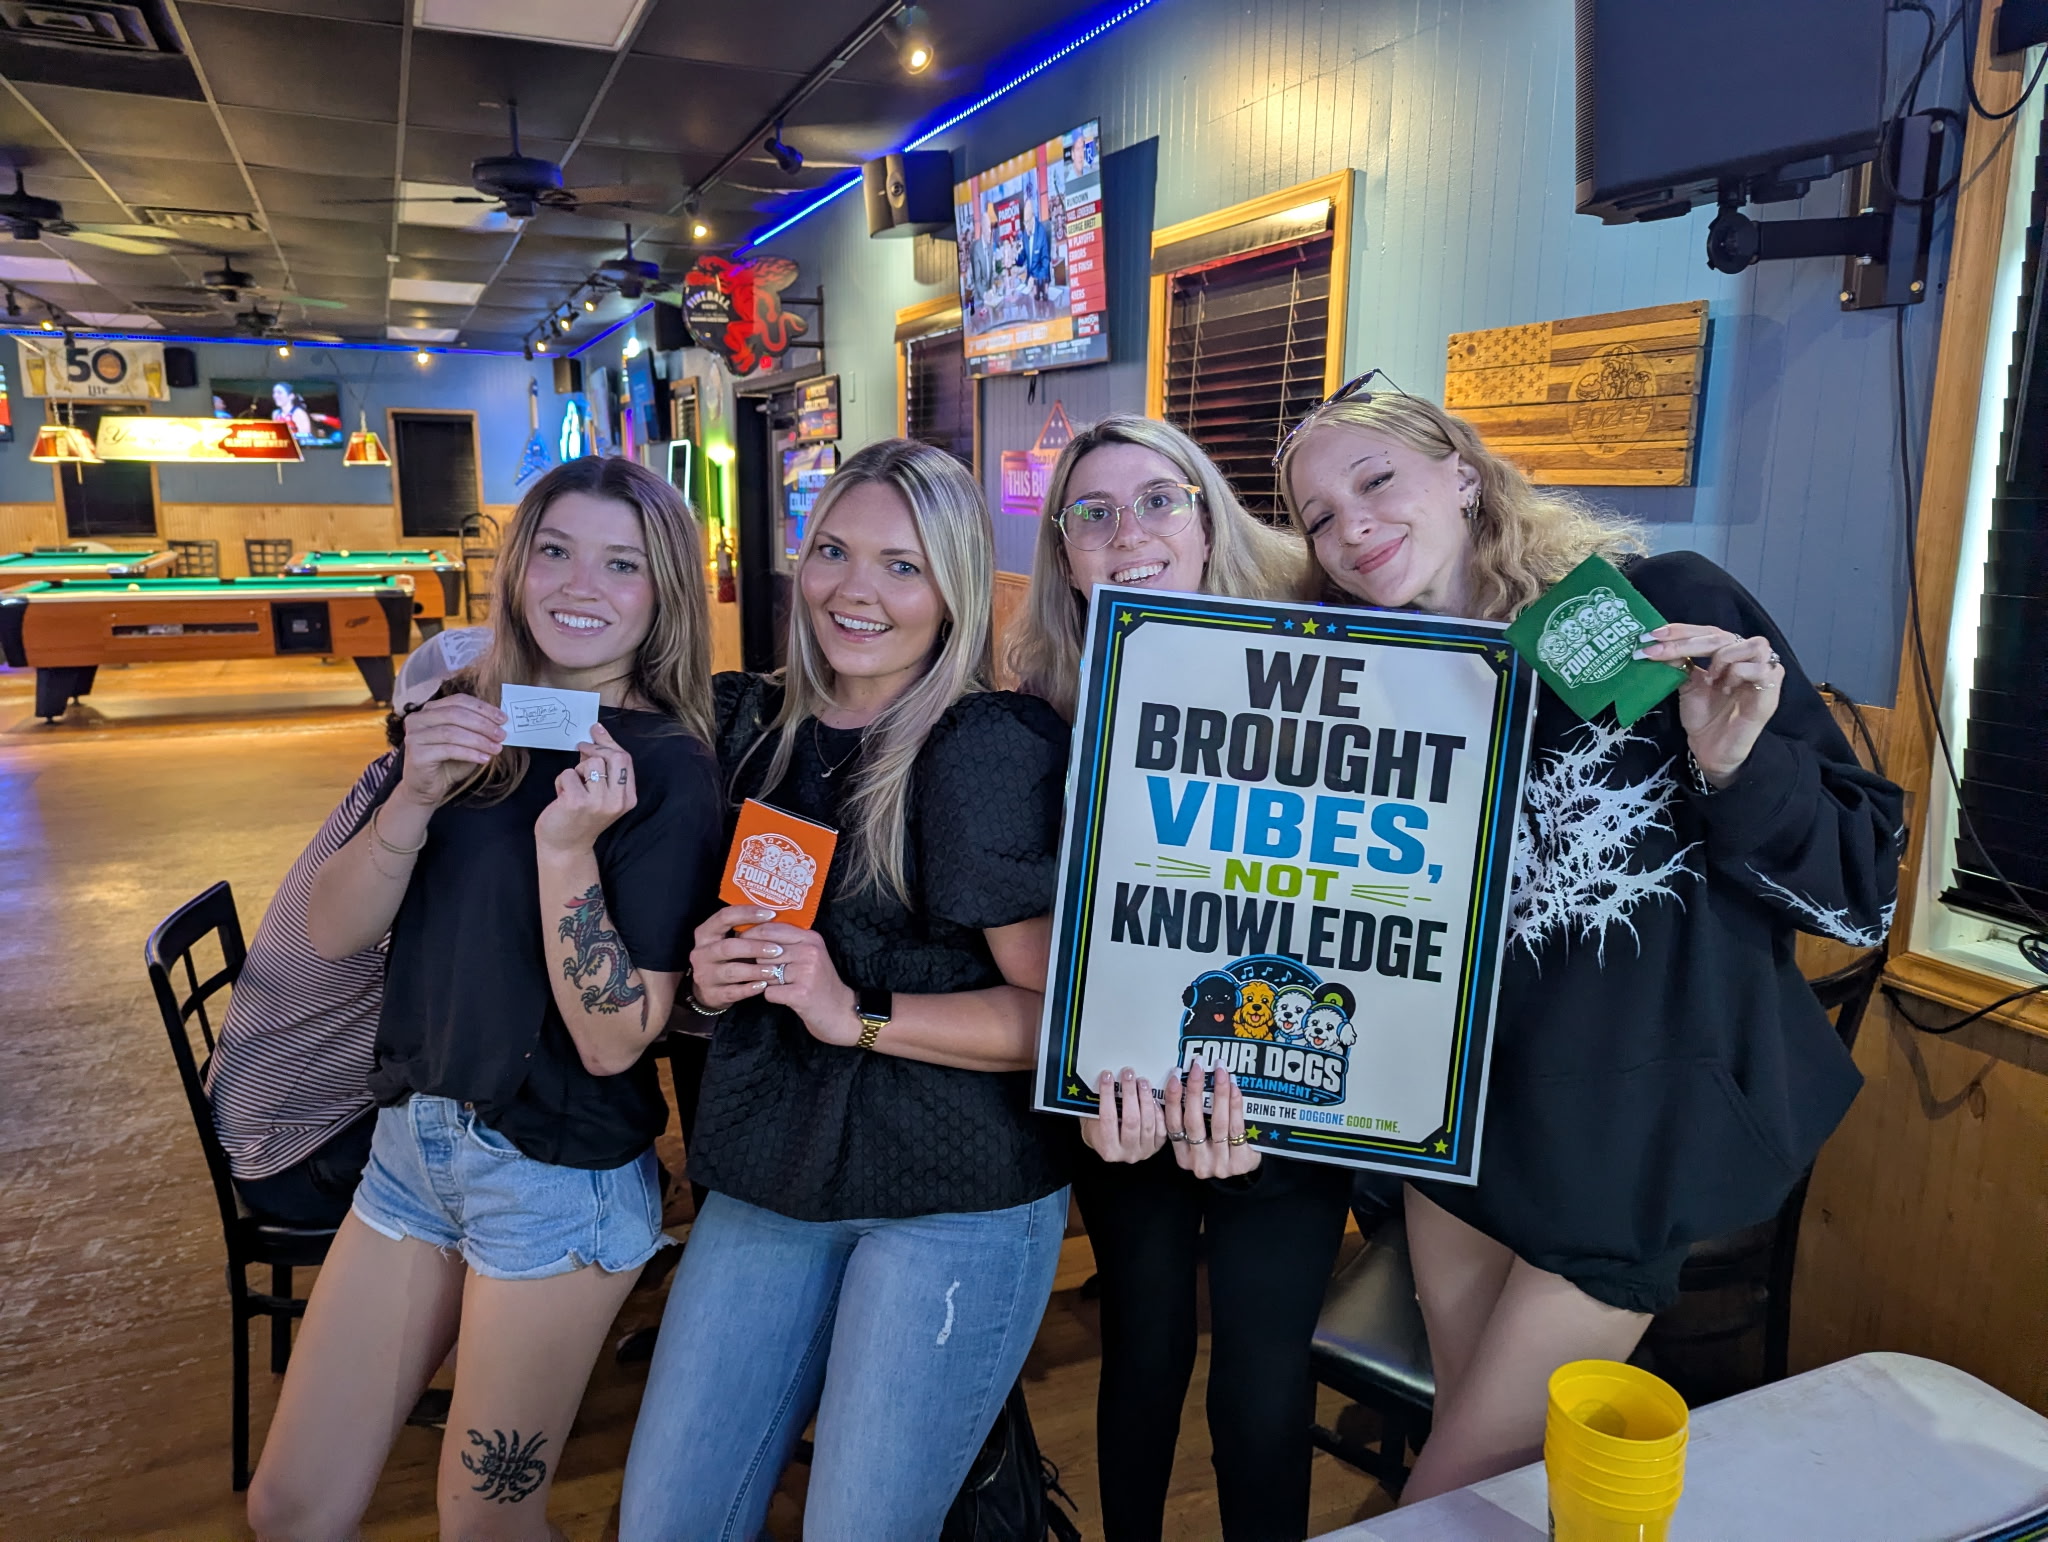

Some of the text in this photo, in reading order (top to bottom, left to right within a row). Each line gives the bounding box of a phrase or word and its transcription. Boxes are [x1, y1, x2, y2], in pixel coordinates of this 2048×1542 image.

[1066, 191, 1089, 208] RUNDOWN
[1067, 217, 1096, 235] GEORGE BRETT
[1073, 231, 1095, 247] PLAYOFFS
[686, 290, 730, 310] FIREBALL
[66, 347, 127, 385] 50
[1008, 470, 1048, 498] THIS BU
[1560, 615, 1640, 683] FOUR DOGS
[1582, 637, 1630, 677] ENTERTAINMENT
[1593, 647, 1631, 679] CHAMPION
[1245, 648, 1365, 719] WE
[1135, 702, 1466, 803] BROUGHT
[1146, 775, 1443, 884] VIBES,
[737, 864, 770, 886] FOUR
[769, 875, 803, 903] DOGS
[1223, 858, 1339, 901] NOT
[1110, 882, 1448, 983] KNOWLEDGE
[1183, 1040, 1343, 1093] FOUR DOGS
[1210, 1075, 1312, 1099] ERTAINMENT
[1246, 1102, 1276, 1117] BRING
[1279, 1106, 1297, 1120] THE
[1299, 1109, 1345, 1126] DOGGONE
[1346, 1115, 1373, 1129] GOOD
[1375, 1119, 1401, 1134] TIME.
